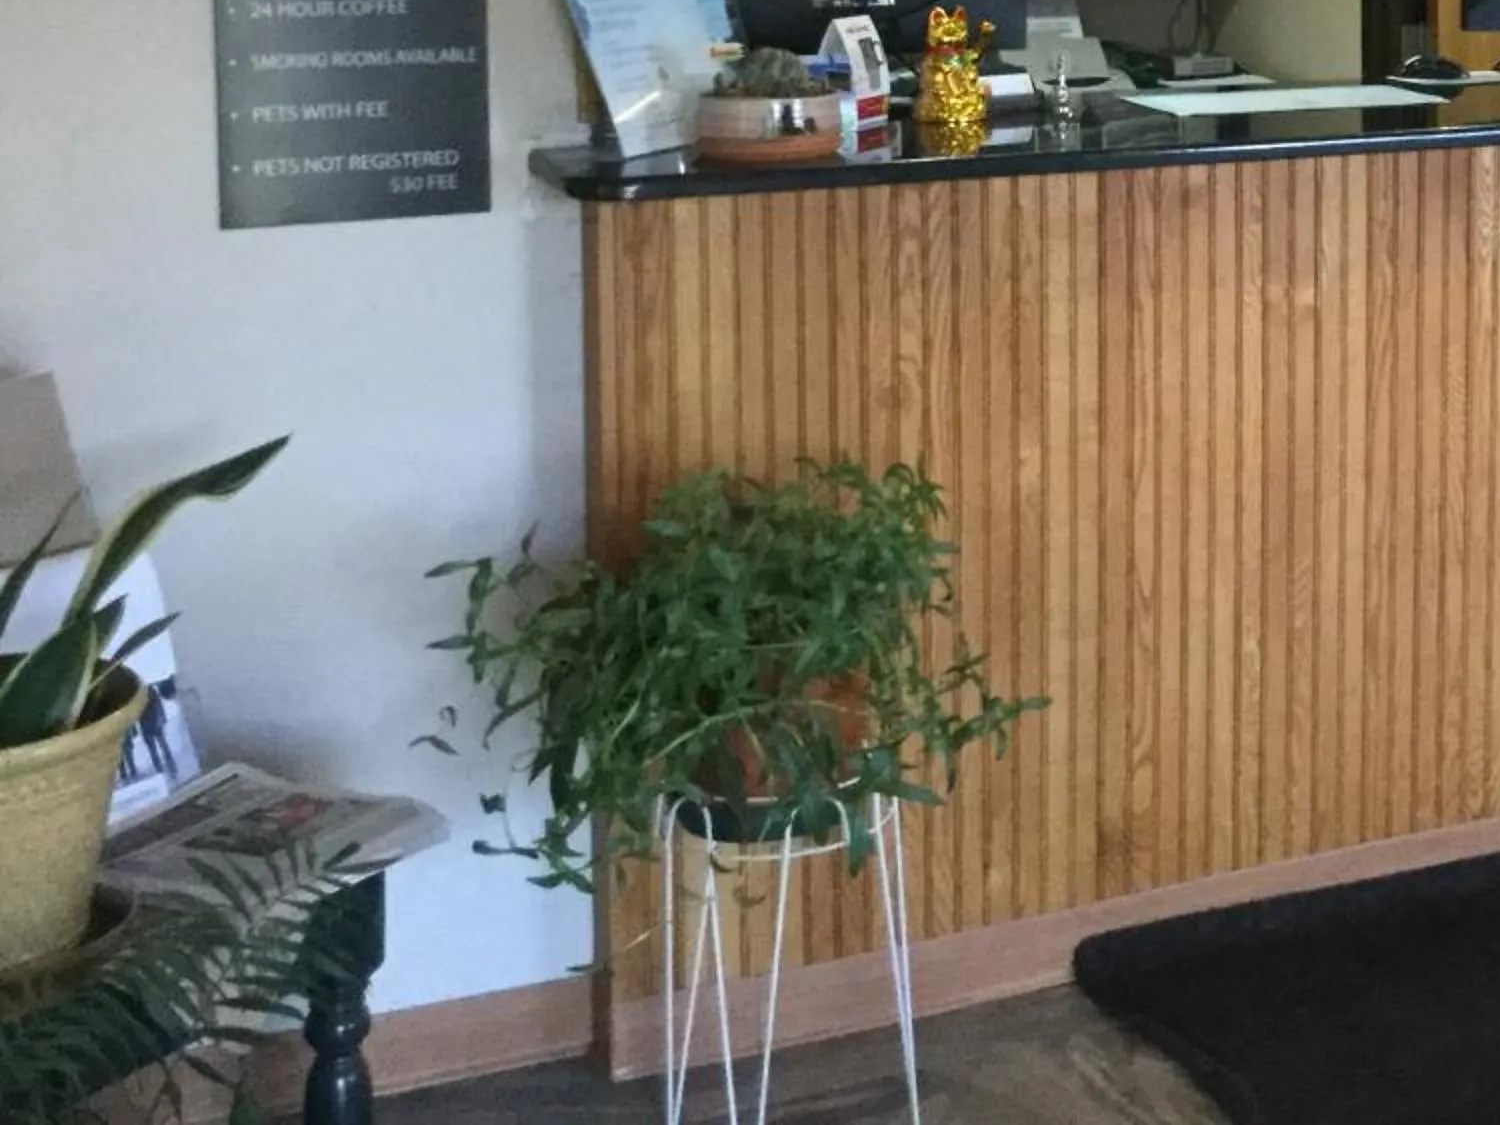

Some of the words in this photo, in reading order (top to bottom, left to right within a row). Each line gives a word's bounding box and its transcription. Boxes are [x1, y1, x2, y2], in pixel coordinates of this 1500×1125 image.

[250, 1, 272, 18] 24
[277, 0, 336, 18] HOUR
[251, 51, 329, 71] SMOKING
[331, 49, 392, 69] ROOMS
[395, 46, 479, 64] AVAILABLE
[252, 104, 299, 123] PETS
[301, 101, 351, 120] WITH
[355, 100, 389, 118] FEE
[253, 157, 300, 177] PETS
[303, 155, 343, 174] NOT
[348, 149, 460, 172] REGISTERED
[427, 173, 459, 191] FEE
